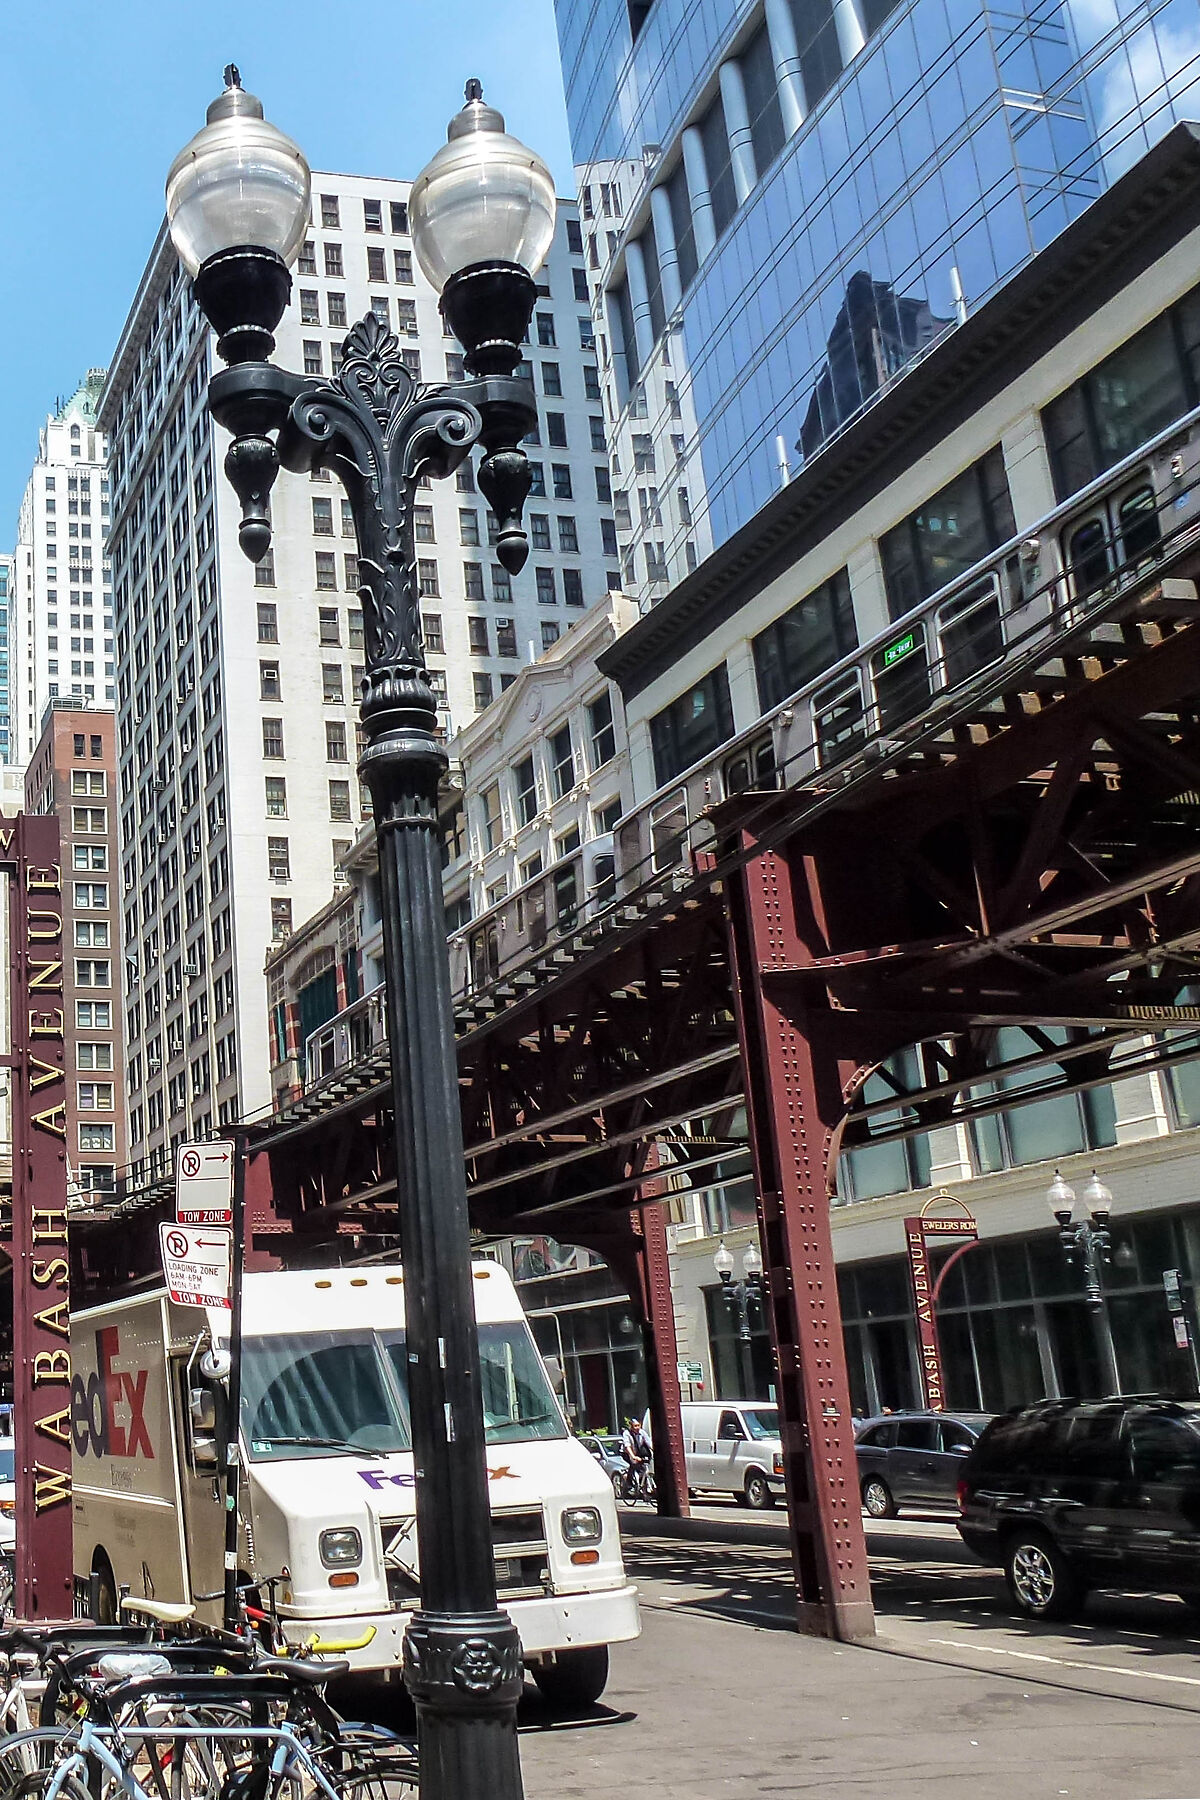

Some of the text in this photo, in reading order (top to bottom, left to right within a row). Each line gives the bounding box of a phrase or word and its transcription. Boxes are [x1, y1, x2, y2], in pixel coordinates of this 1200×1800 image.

[26, 863, 67, 1137] AVENUE
[182, 1210, 226, 1222] TOW ZONE
[922, 1221, 959, 1230] EWELERS
[168, 1262, 219, 1276] LOADING ZONE
[909, 1232, 932, 1322] AVENUE
[176, 1291, 226, 1307] TOW ZONE
[31, 1205, 73, 1512] WABASH
[922, 1344, 944, 1414] ABASH
[71, 1325, 156, 1459] edEx
[356, 1465, 522, 1490] Fex
